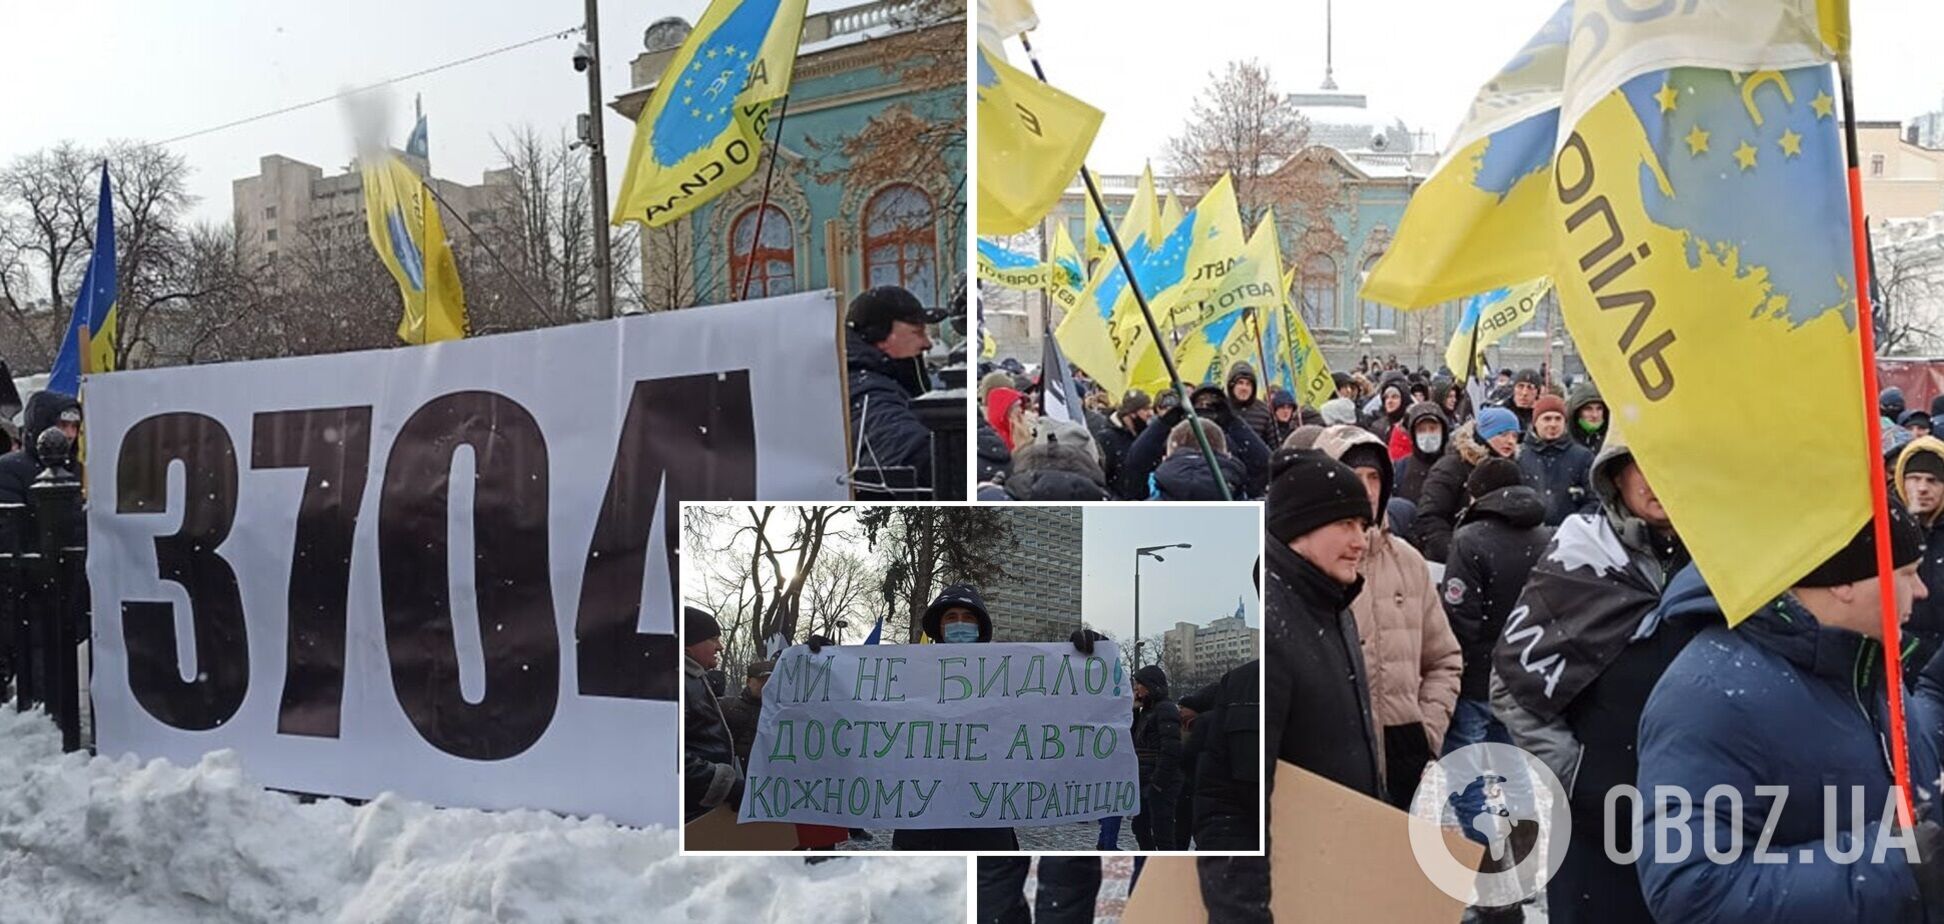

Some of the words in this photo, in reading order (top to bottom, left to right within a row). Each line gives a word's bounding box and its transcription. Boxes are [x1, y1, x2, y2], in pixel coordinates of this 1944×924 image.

[116, 369, 757, 761] 3704
[776, 654, 835, 703] МИ
[852, 657, 906, 701] НЕ
[937, 654, 1122, 704] БИДЛО!
[768, 718, 989, 763] ДОСТУПНЕ
[1005, 724, 1118, 760] АВТО
[748, 776, 942, 818] КОЖНОМУ
[969, 780, 1135, 820] УКРАЇНЦЮ
